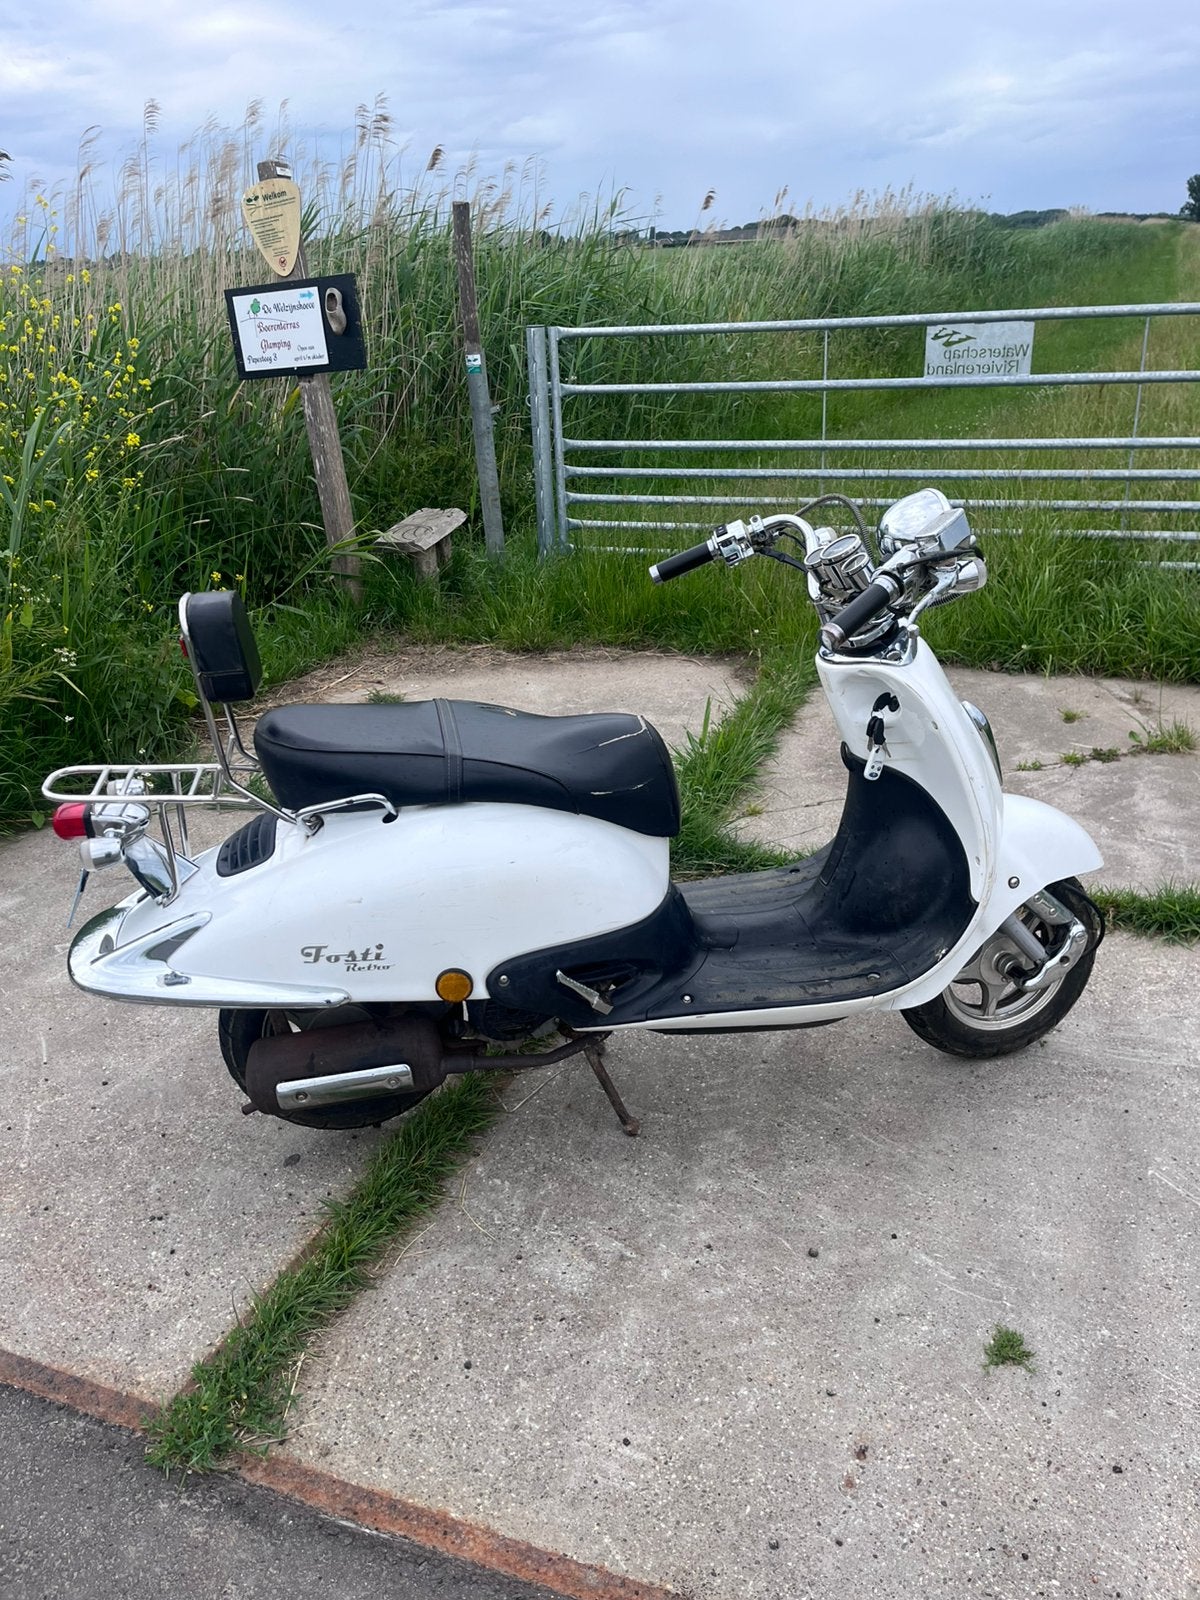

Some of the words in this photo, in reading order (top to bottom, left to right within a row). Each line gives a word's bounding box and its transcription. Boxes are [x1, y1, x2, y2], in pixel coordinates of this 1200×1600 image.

[262, 190, 287, 202] Welkom
[262, 303, 272, 314] De
[273, 301, 315, 314] Welzijnshoeve
[257, 321, 300, 333] Boerenterras
[260, 338, 291, 353] Glamping
[273, 352, 278, 361] 3
[344, 963, 396, 972] Retro
